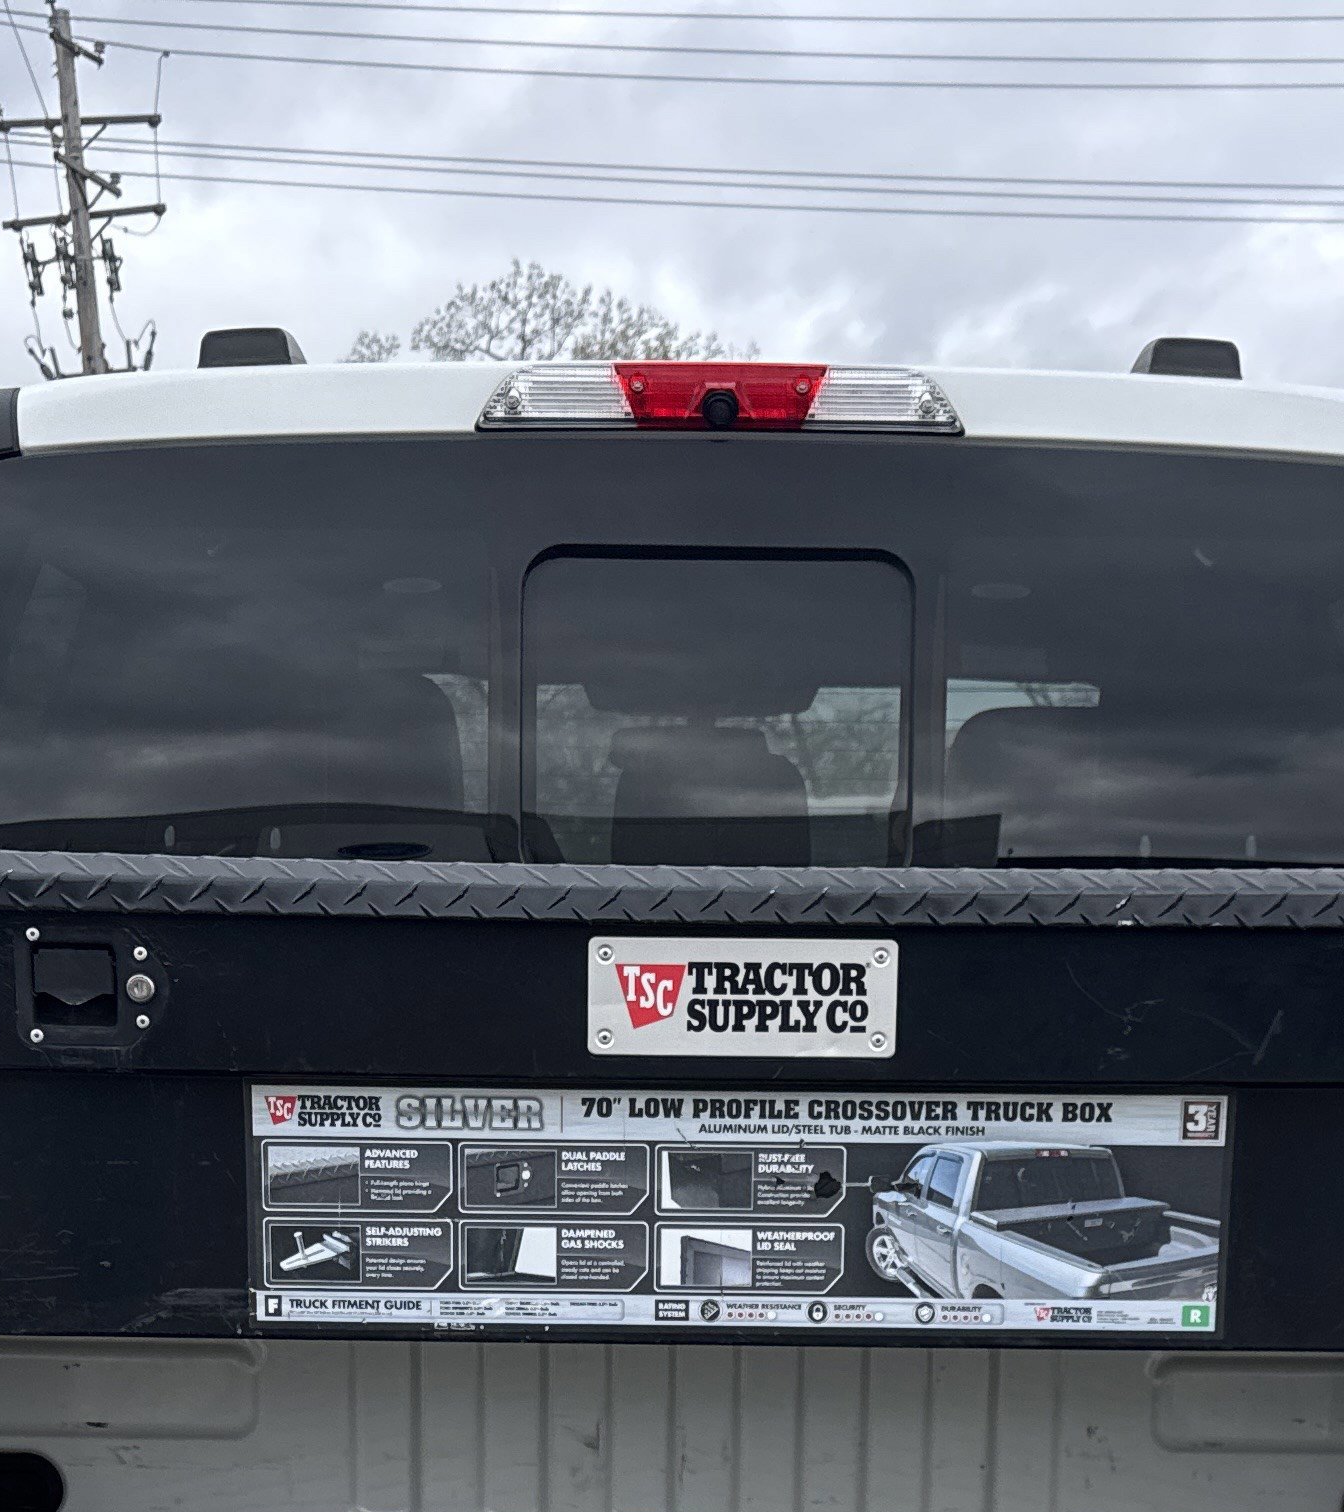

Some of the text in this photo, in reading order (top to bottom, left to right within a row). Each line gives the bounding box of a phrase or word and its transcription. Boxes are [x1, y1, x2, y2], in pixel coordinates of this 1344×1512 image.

[687, 962, 867, 996] TRACTOR
[622, 965, 674, 1017] TSC
[687, 999, 823, 1033] SUPPLY
[268, 1096, 292, 1120] TSC
[297, 1095, 382, 1111] TRACTOR
[396, 1094, 545, 1130] SILVER
[581, 1097, 1113, 1122] 70" LOW PROFILE CROSSOVER TRUCK BOX
[297, 1112, 361, 1127] SUPPLY
[1186, 1104, 1208, 1131] 3
[699, 1123, 768, 1134] ALUMINUM
[771, 1124, 826, 1136] LID/STEEL
[829, 1125, 851, 1135] TUB
[861, 1125, 898, 1136] MATTE
[903, 1126, 944, 1136] BLACK
[945, 1126, 986, 1137] FINISH
[364, 1149, 419, 1158] ADVANCED
[561, 1151, 626, 1161] DUAL PADDLE
[364, 1160, 410, 1169] FEATURES
[561, 1162, 602, 1171] LATCHES
[365, 1226, 443, 1237] SELF-ADJUSTING
[561, 1229, 616, 1238] DAMPENED
[757, 1231, 835, 1241] WEATHERPROOF
[365, 1237, 409, 1247] STRIKERS
[561, 1239, 625, 1249] GAS SHOCKS
[757, 1242, 796, 1251] LID SEAL
[267, 1298, 279, 1314] F
[289, 1299, 422, 1311] TRUCK FITMENT GUIDE
[941, 1305, 983, 1313] DURABILITY
[1050, 1307, 1092, 1315] TRACTOR
[1189, 1309, 1202, 1323] R
